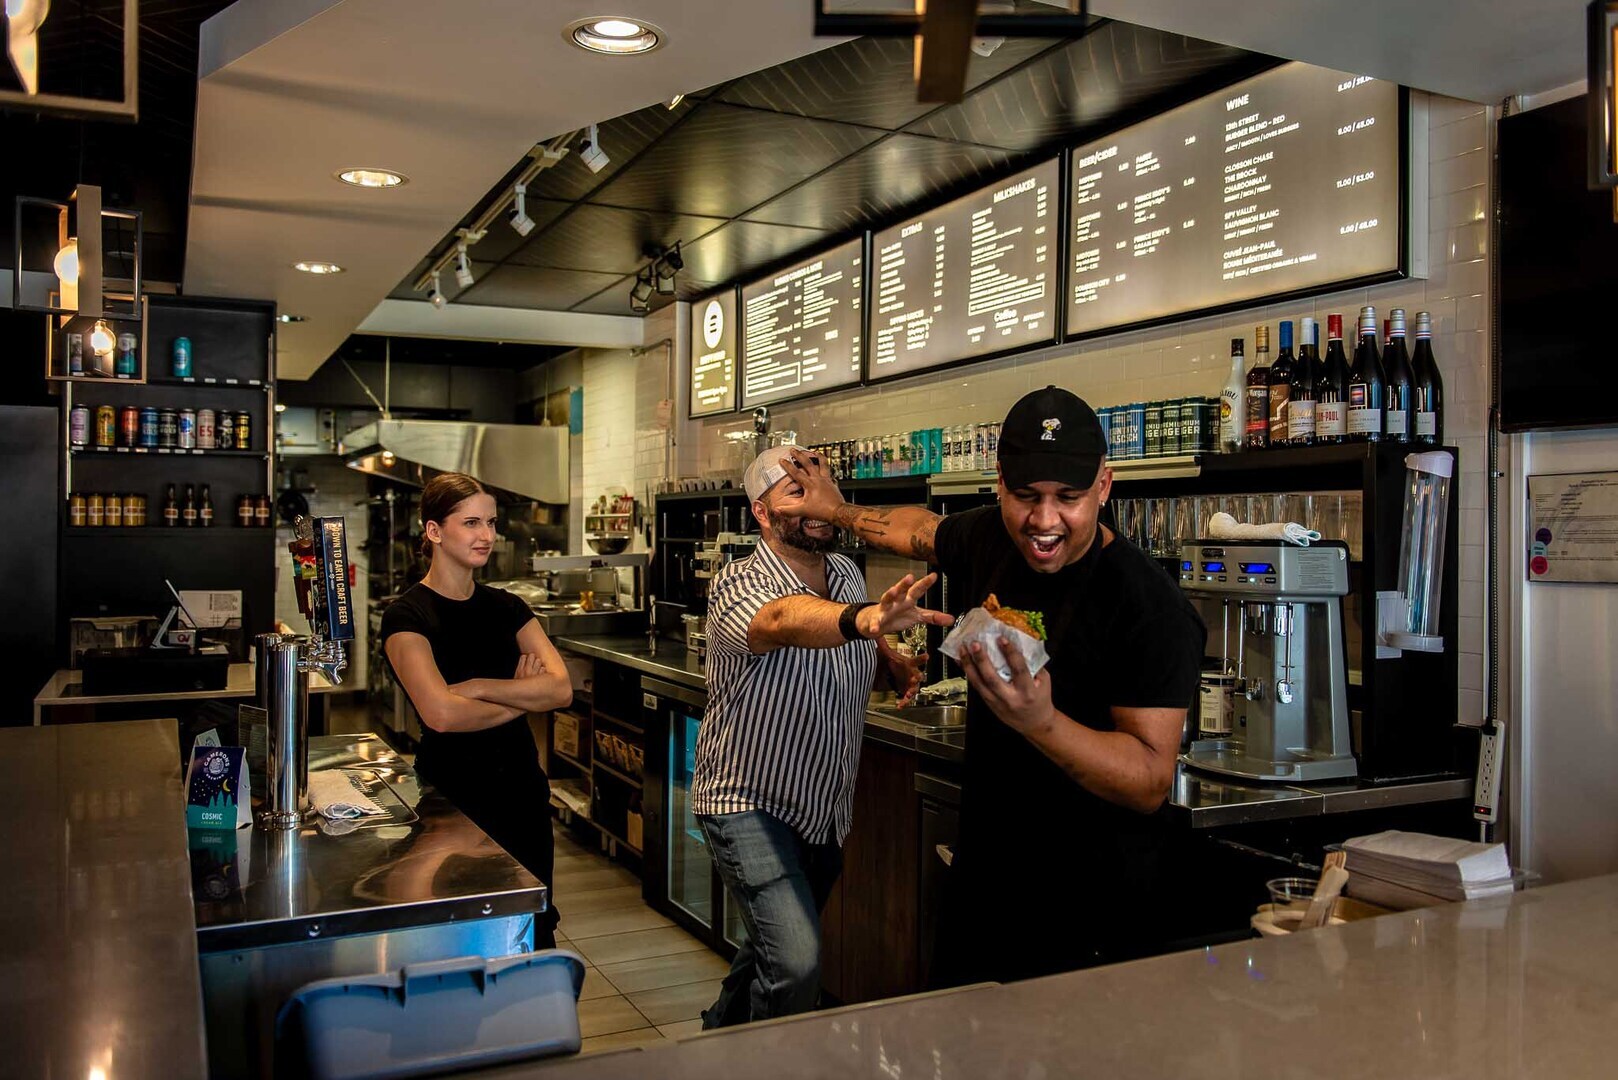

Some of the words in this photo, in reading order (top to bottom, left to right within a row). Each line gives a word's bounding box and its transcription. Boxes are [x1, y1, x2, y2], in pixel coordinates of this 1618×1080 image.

[1226, 93, 1249, 111] WINE
[1225, 128, 1248, 142] BURGER
[1249, 121, 1267, 133] BLEND
[1273, 114, 1285, 125] RED
[1238, 113, 1259, 127] STREET
[1224, 158, 1252, 173] CLOSSON
[1253, 151, 1274, 164] CHASE
[1224, 174, 1235, 184] THE
[1236, 167, 1257, 180] BROCK
[1224, 174, 1267, 194] CHARDONNAY
[994, 178, 1036, 203] MILKSHAKES
[1224, 211, 1235, 220] SPY
[1236, 204, 1257, 218] VALLEY
[1224, 215, 1258, 230] SAUVIGNON
[1259, 208, 1280, 221] BLANC
[1242, 240, 1276, 255] JEAN-PAUL
[334, 549, 342, 558] TO
[334, 560, 344, 581] EARTH
[336, 583, 346, 605] CRAFT
[338, 606, 348, 625] BEER
[202, 812, 223, 820] COSMIC
